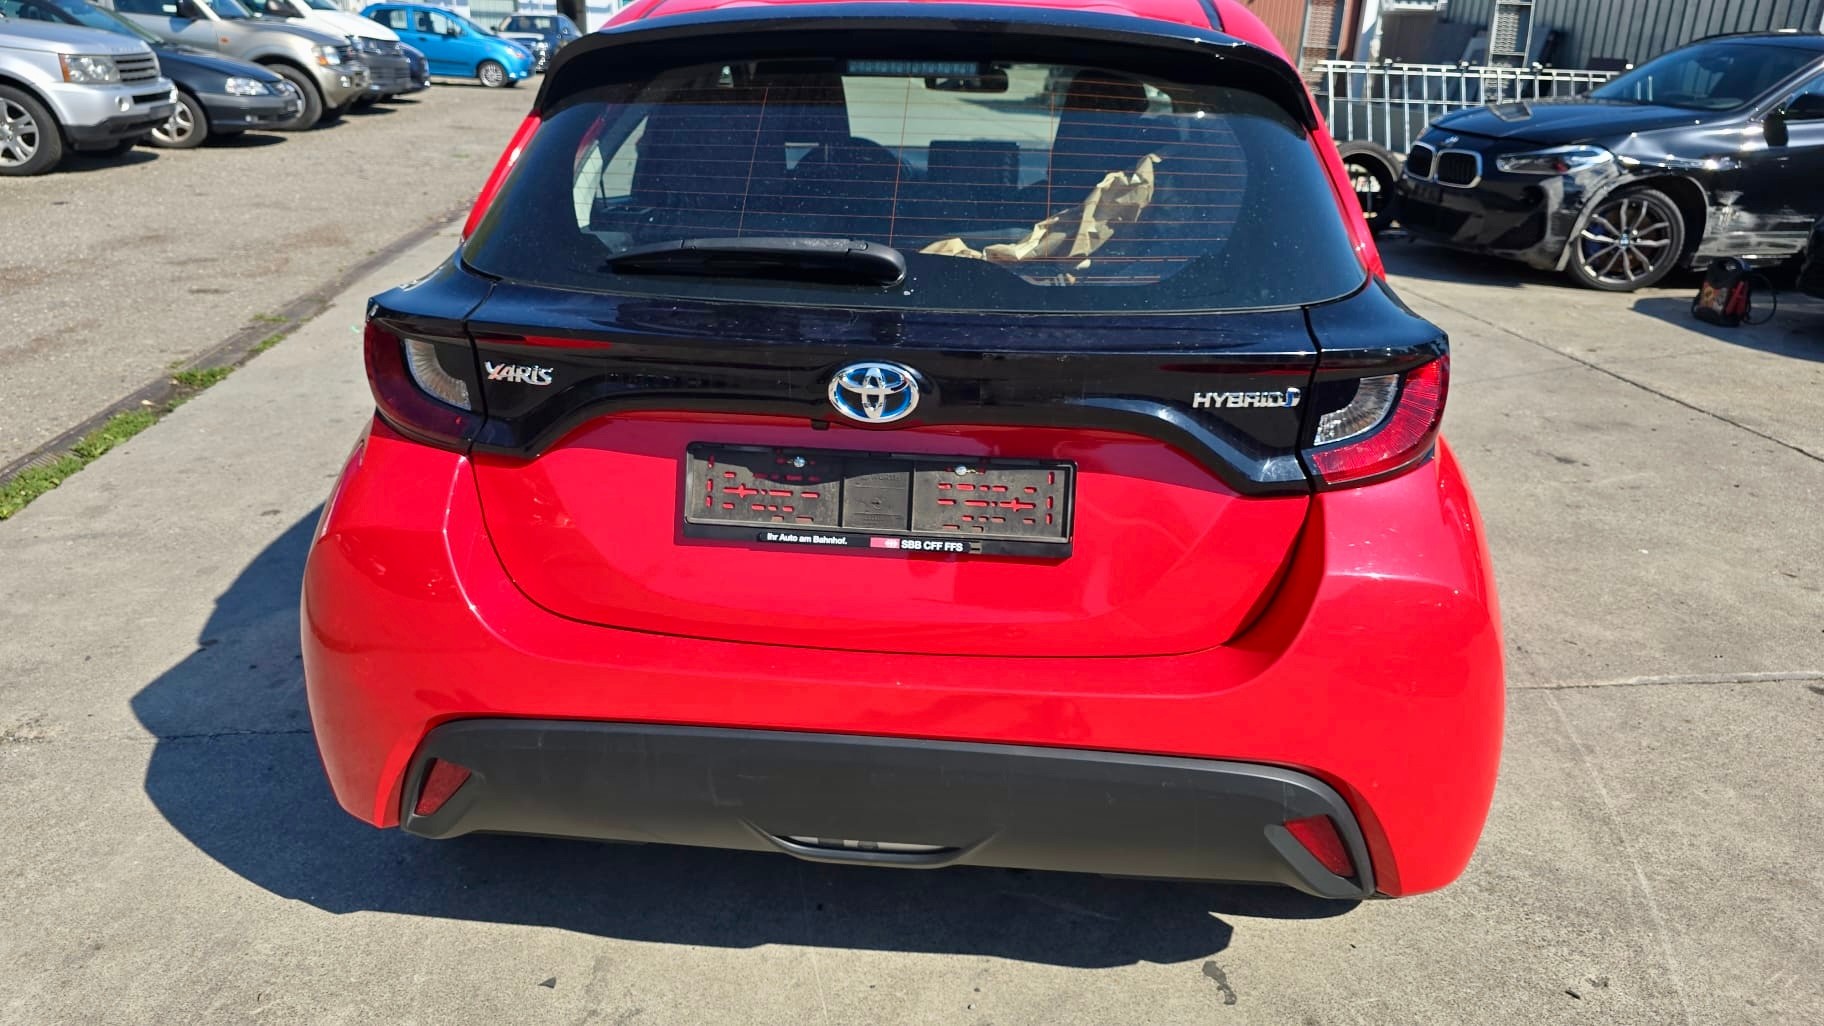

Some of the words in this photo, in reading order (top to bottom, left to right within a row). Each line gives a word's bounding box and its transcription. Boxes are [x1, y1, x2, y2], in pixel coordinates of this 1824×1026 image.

[1192, 391, 1284, 408] HYBRID
[766, 532, 779, 541] Ihr
[779, 533, 797, 542] Auto
[799, 535, 812, 543] am
[812, 535, 848, 545] Bahnhof.
[901, 539, 921, 549] SBB
[923, 540, 943, 551] CFF
[944, 541, 964, 552] FFS
